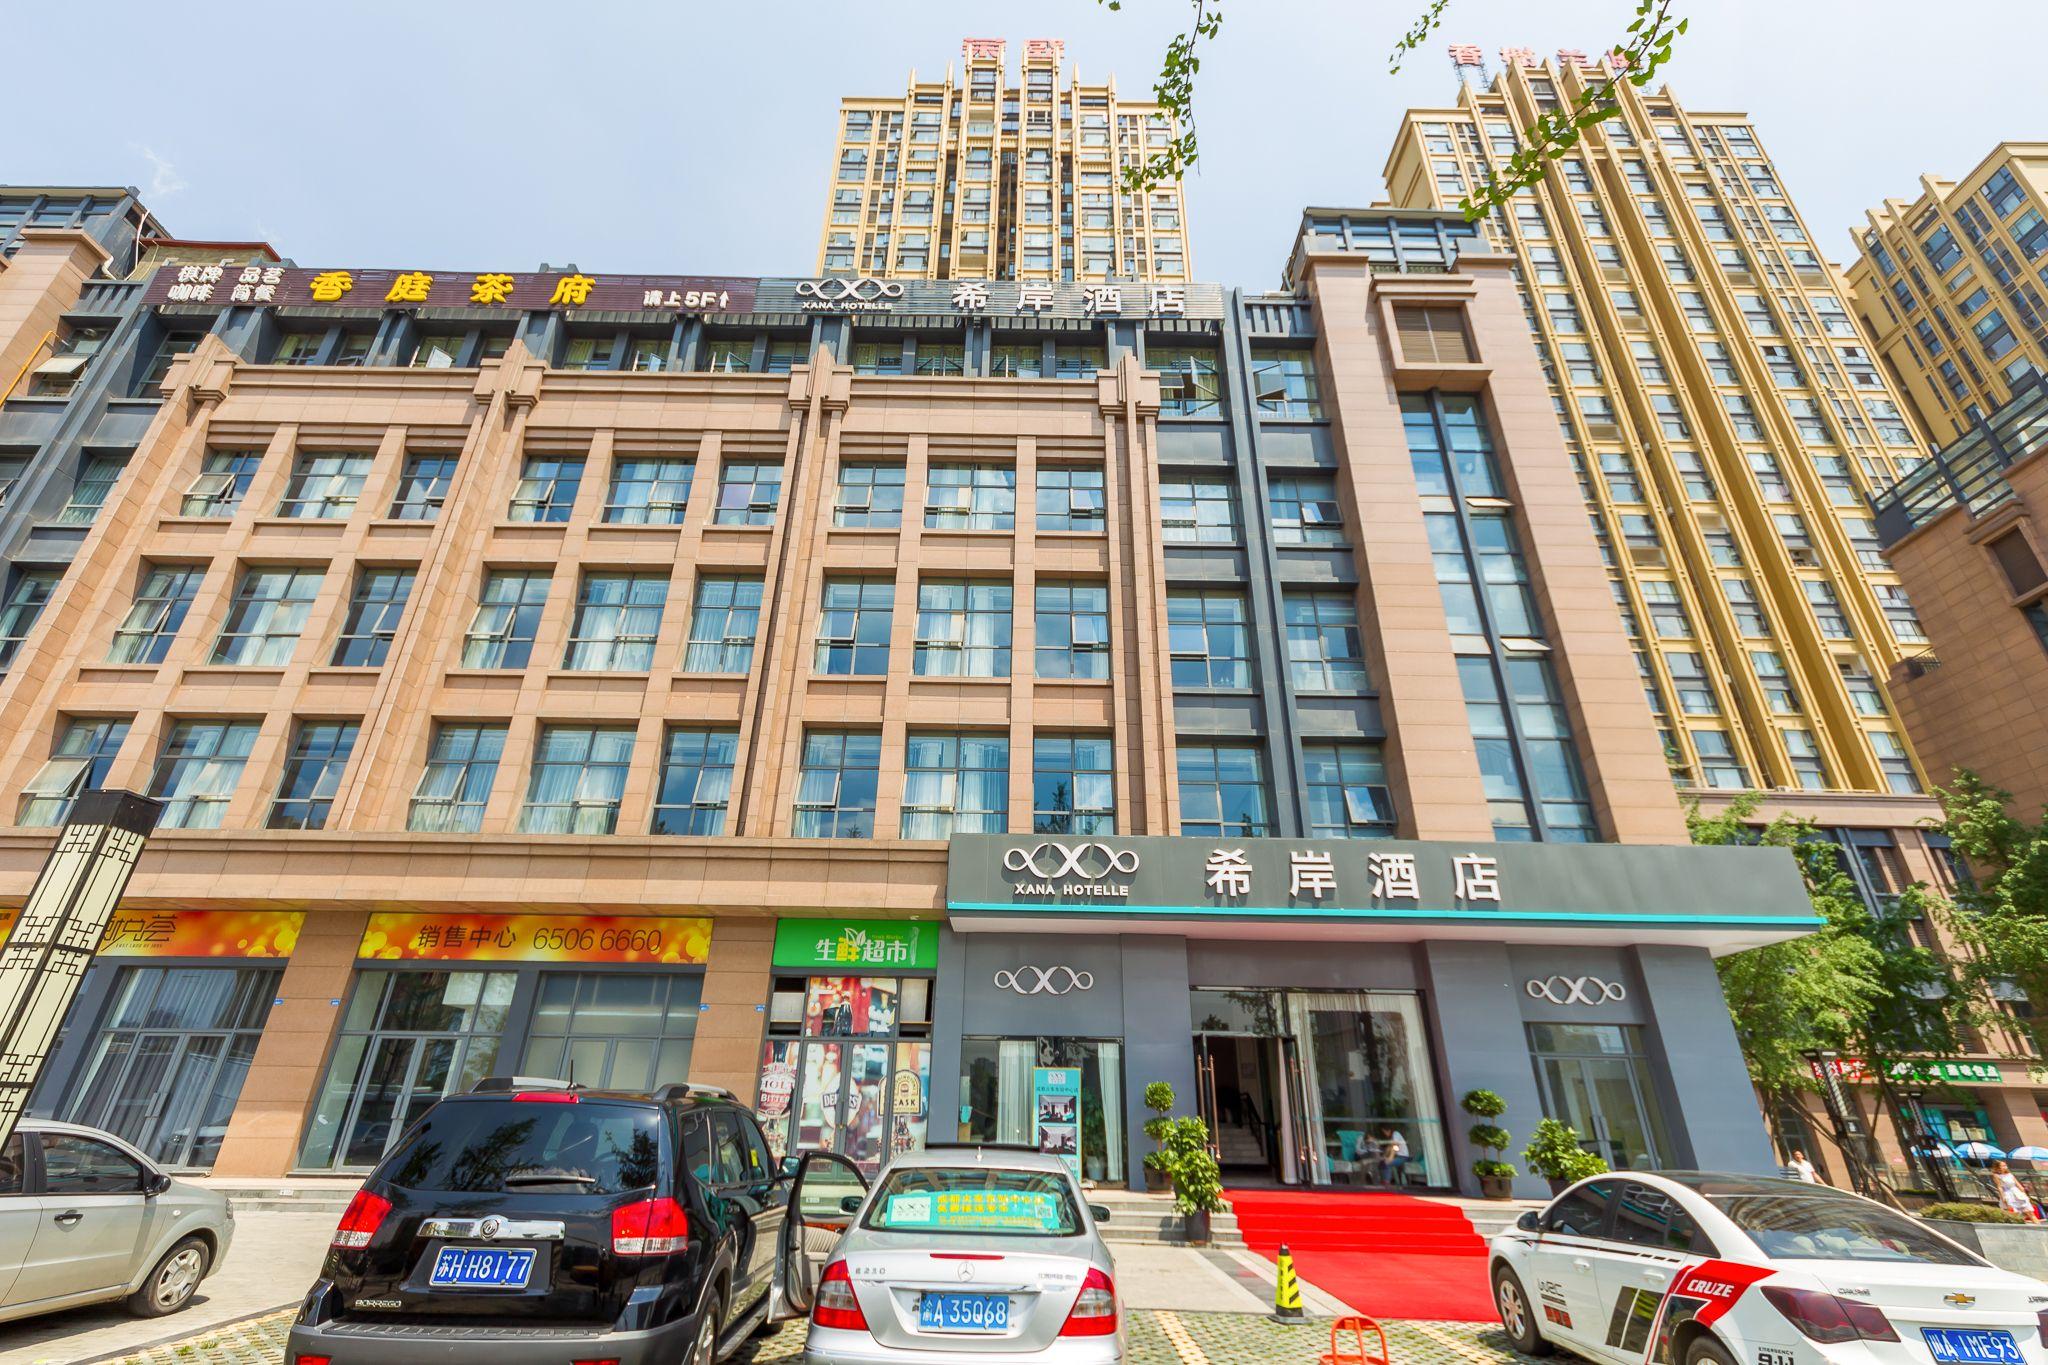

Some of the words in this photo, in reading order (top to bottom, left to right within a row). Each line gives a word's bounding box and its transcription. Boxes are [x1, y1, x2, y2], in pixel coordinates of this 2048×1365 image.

[167, 283, 215, 302] 咖啡
[309, 271, 597, 305] 香庭茶府
[952, 281, 1185, 313] 希岸酒店
[802, 301, 835, 310] XANA
[840, 302, 893, 310] HOTELLE
[1206, 848, 1501, 901] 希岸酒店
[1014, 883, 1055, 895] XANA
[1063, 884, 1129, 897] HOTELLE
[417, 924, 516, 949] 销售中心
[533, 927, 595, 951] 6506
[600, 928, 662, 952] 6660
[814, 937, 909, 963] 生鲜超市
[1686, 1278, 1735, 1298] CRUZE
